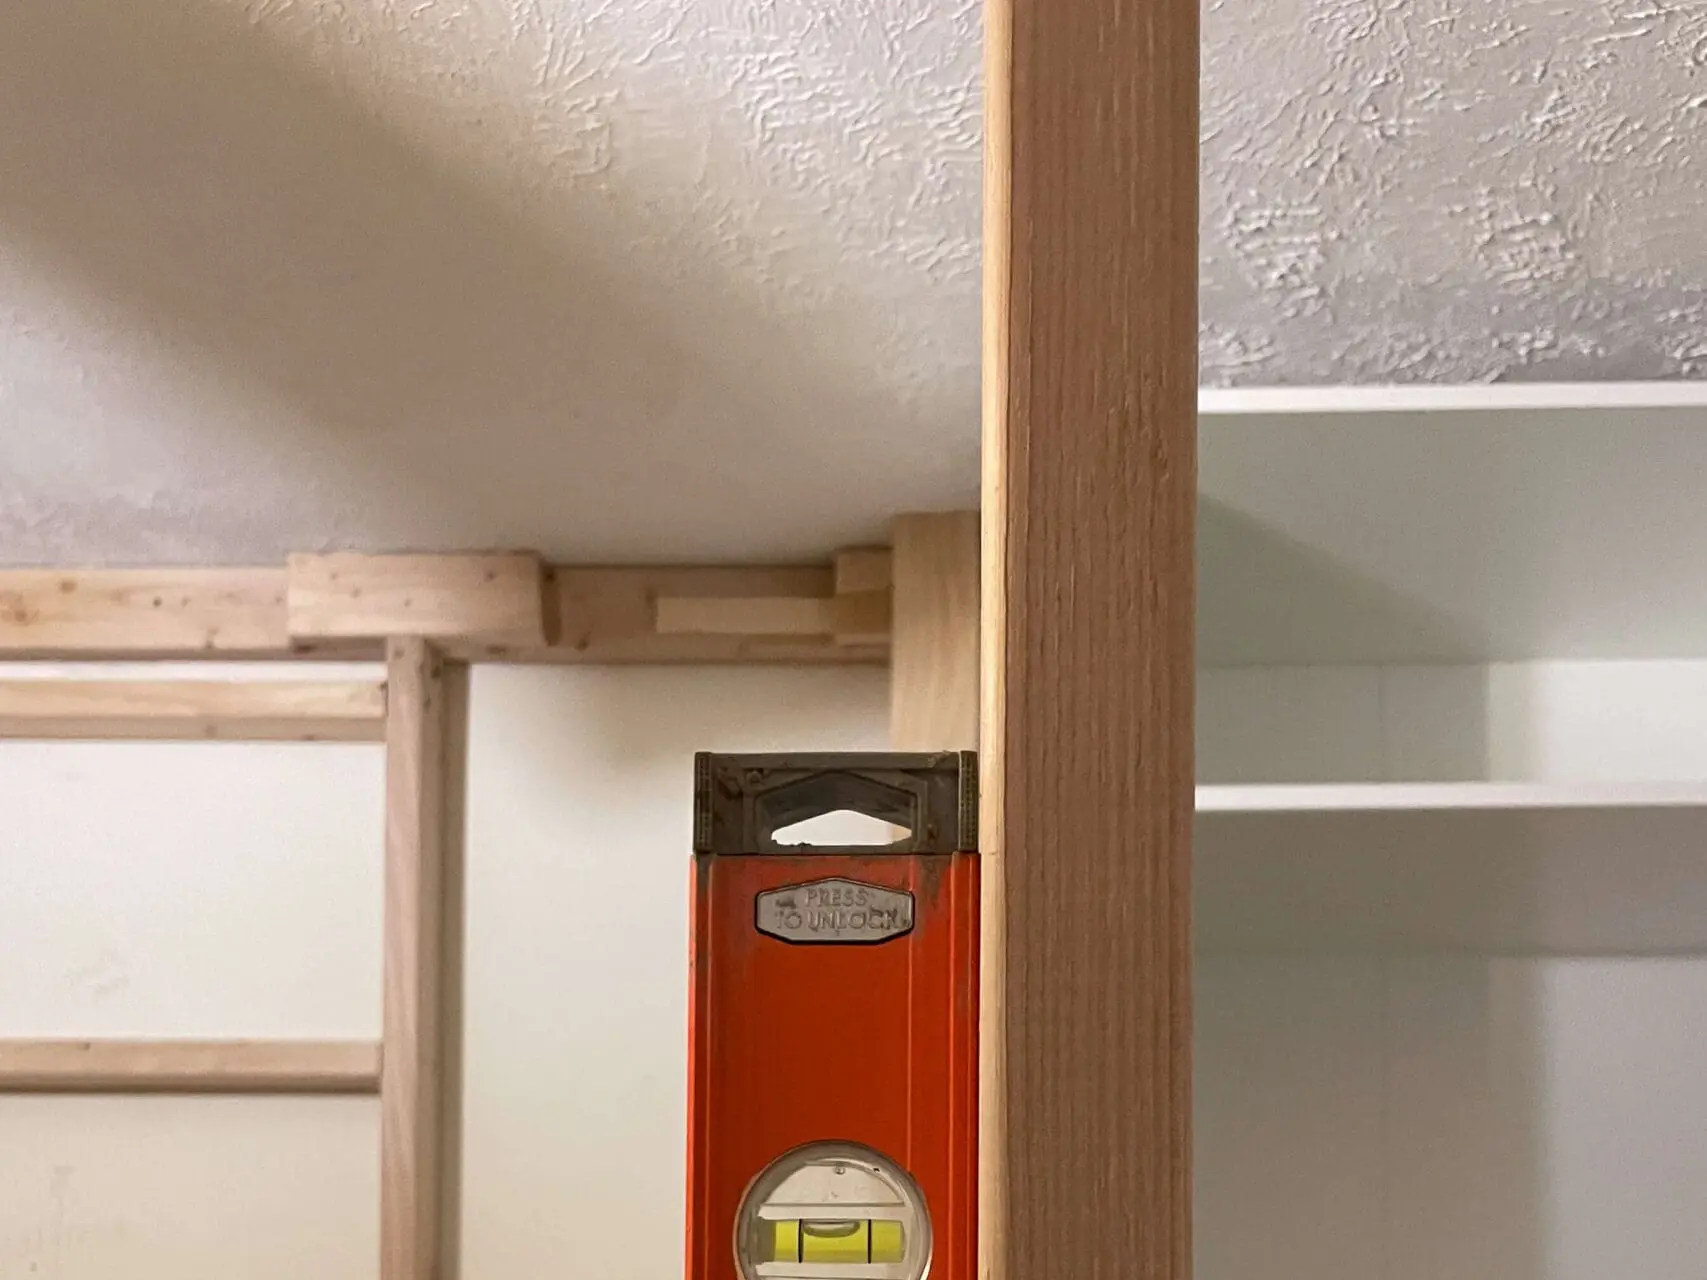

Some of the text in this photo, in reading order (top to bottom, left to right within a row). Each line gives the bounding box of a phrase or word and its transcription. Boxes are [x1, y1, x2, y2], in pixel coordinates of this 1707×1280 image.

[805, 888, 868, 907] PRESS
[774, 910, 899, 931] TO UNLOCK
